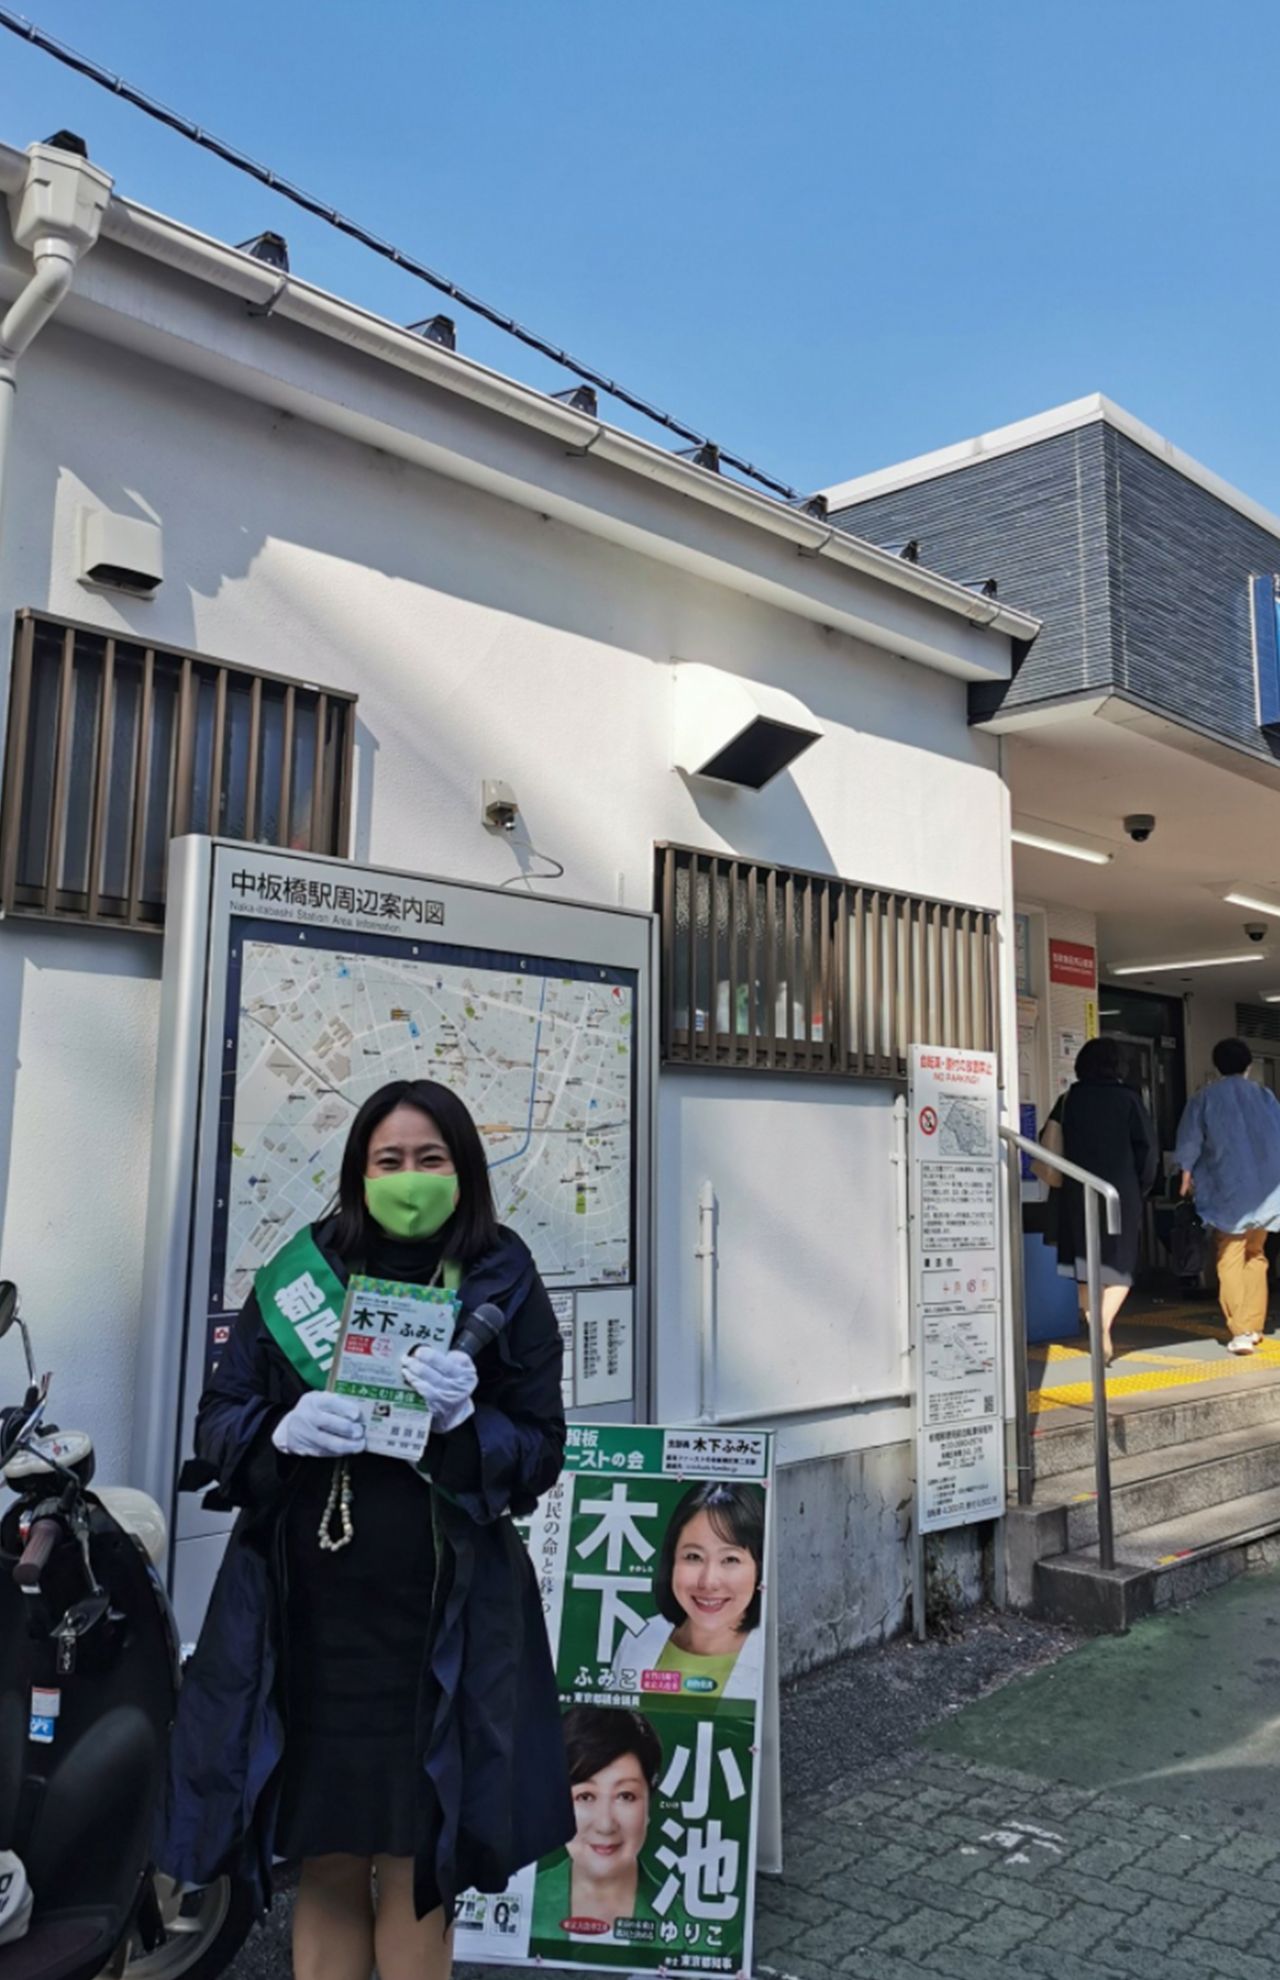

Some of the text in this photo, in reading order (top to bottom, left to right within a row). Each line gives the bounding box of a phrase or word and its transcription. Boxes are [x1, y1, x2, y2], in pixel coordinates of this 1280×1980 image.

[231, 868, 445, 926] 中板橋駅周辺案内図
[297, 909, 329, 922] Station
[332, 915, 352, 926] Area
[274, 1270, 342, 1372] 都民
[351, 1307, 446, 1342] 木下 ふみこ
[692, 1437, 761, 1455] 木下ふみこ
[572, 1483, 658, 1664] 木下
[574, 1666, 637, 1690] ふみこ
[651, 1721, 746, 1920] 小池
[660, 1921, 722, 1946] ゆりこ
[680, 1954, 732, 1970] 東京都知事
